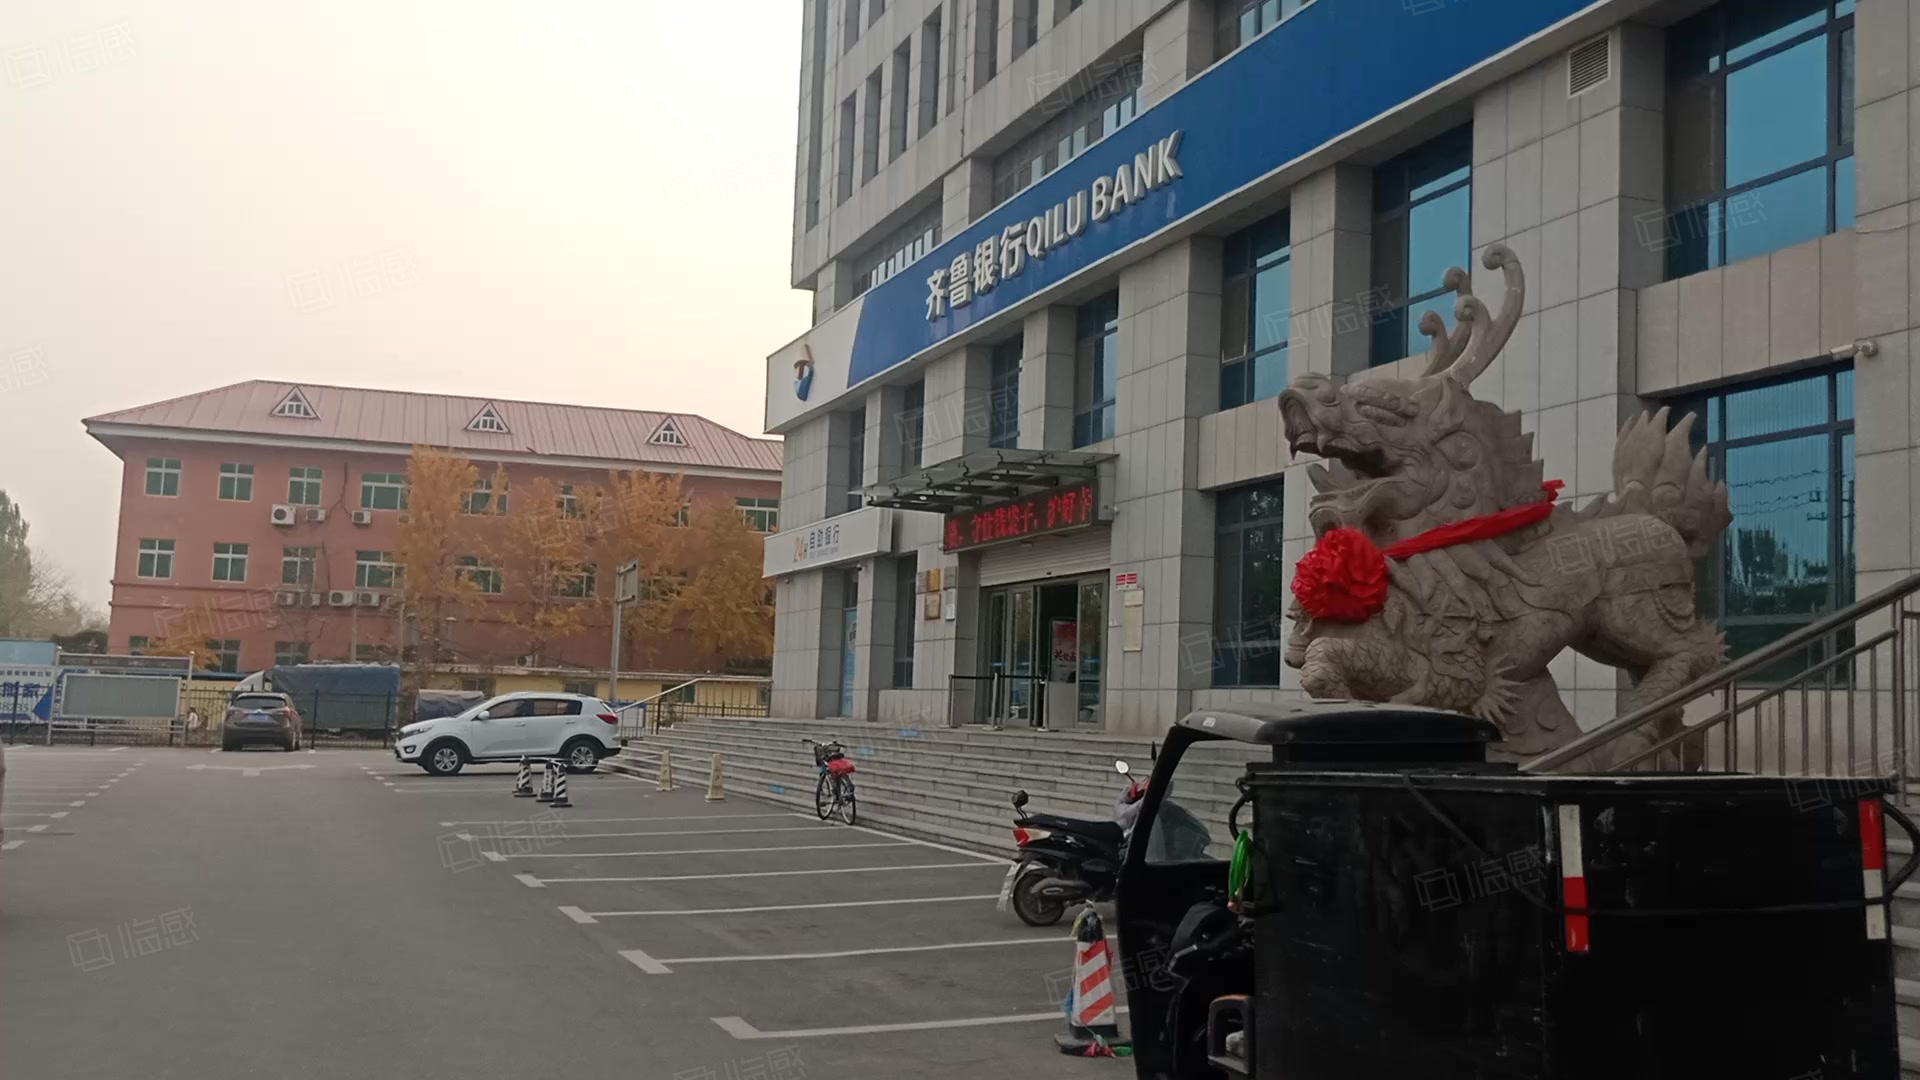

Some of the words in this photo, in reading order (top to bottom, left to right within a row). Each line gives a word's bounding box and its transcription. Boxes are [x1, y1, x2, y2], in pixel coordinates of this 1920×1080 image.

[925, 221, 1025, 321] 齐鲁银行
[1026, 190, 1088, 259] QILU
[1092, 129, 1183, 222] BANK
